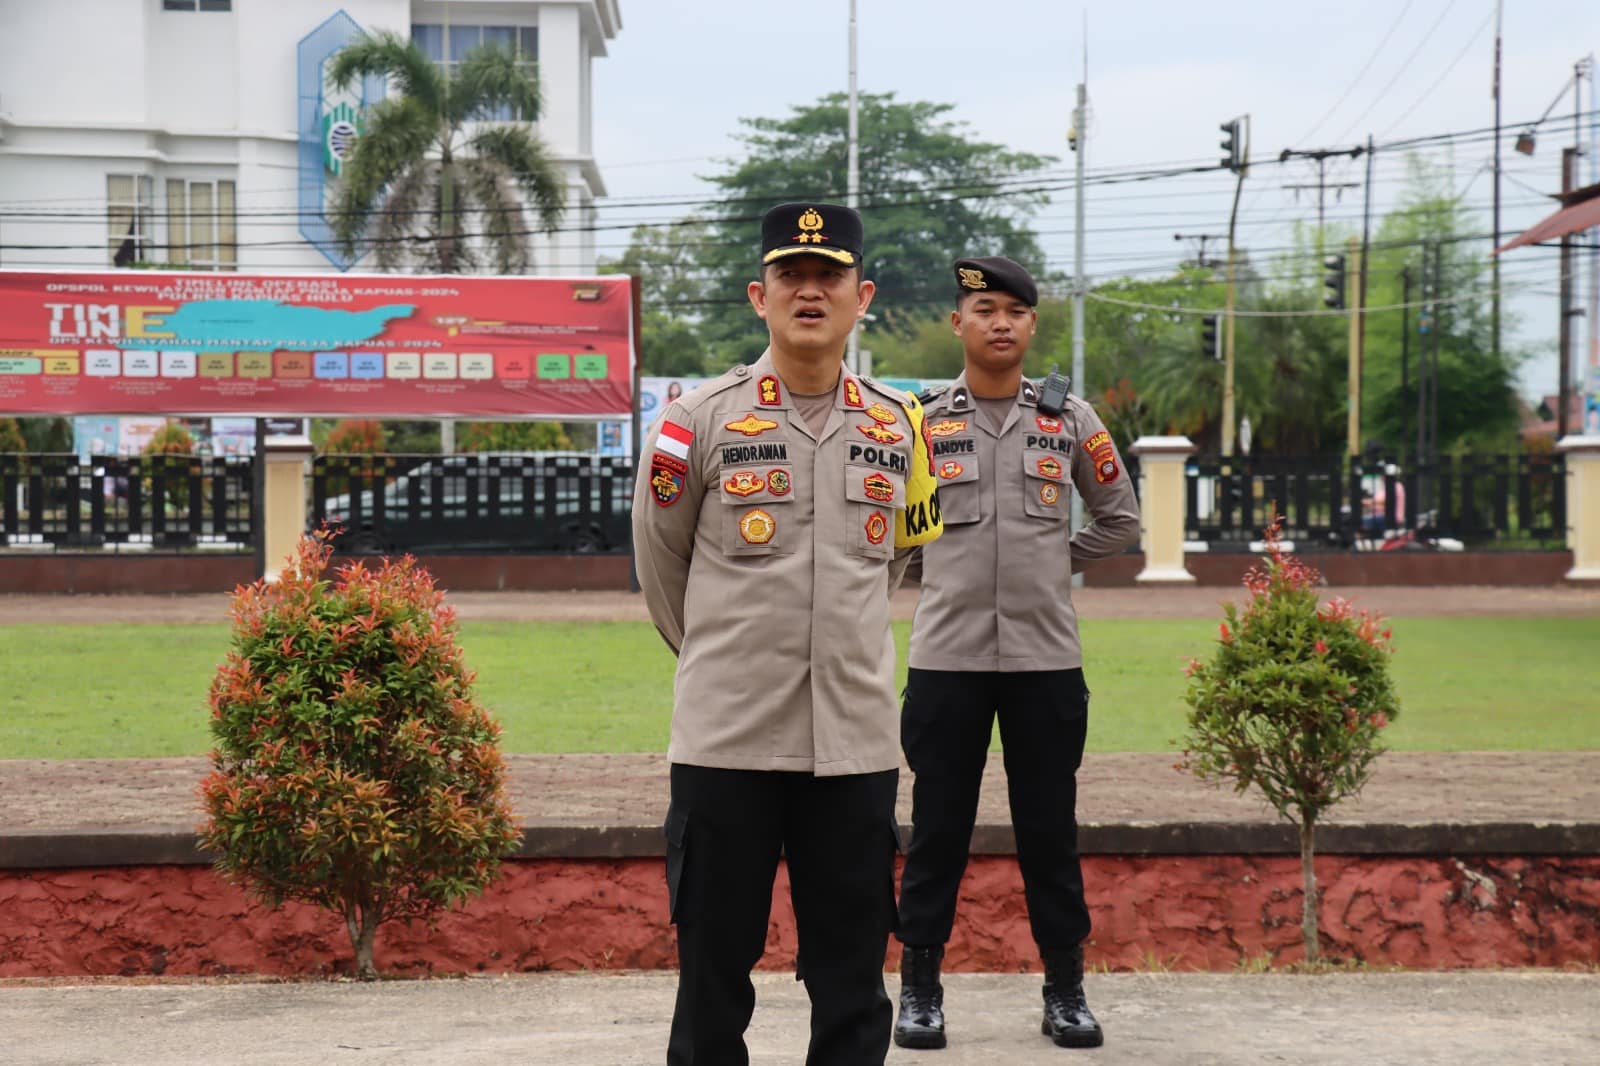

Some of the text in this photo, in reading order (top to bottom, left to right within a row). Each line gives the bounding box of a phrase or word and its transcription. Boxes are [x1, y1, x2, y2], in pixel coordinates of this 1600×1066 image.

[46, 283, 108, 292] OPSPOL
[722, 443, 787, 464] HENDRAWAN
[1027, 435, 1071, 454] POLRI
[850, 444, 906, 472] POLRI
[905, 501, 929, 537] KA
